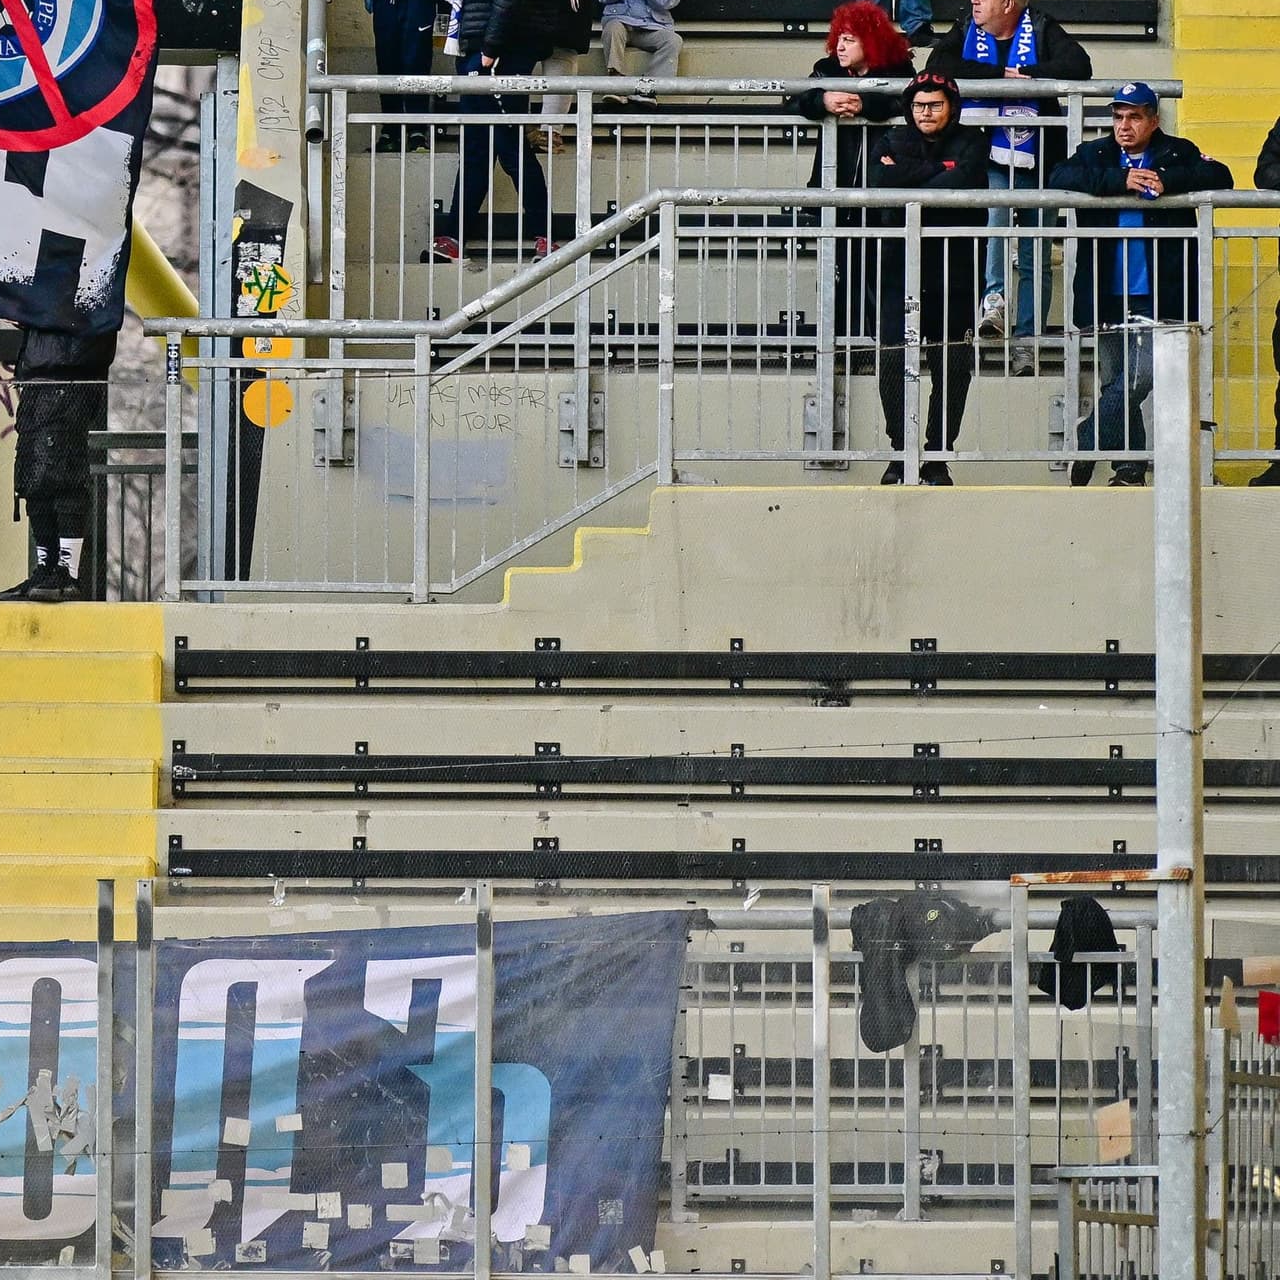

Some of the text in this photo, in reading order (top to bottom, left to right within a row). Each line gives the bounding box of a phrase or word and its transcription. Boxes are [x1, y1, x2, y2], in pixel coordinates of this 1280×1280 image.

[1017, 9, 1034, 55] АРНА
[388, 382, 459, 408] ULTAS
[461, 412, 514, 432] TOUR
